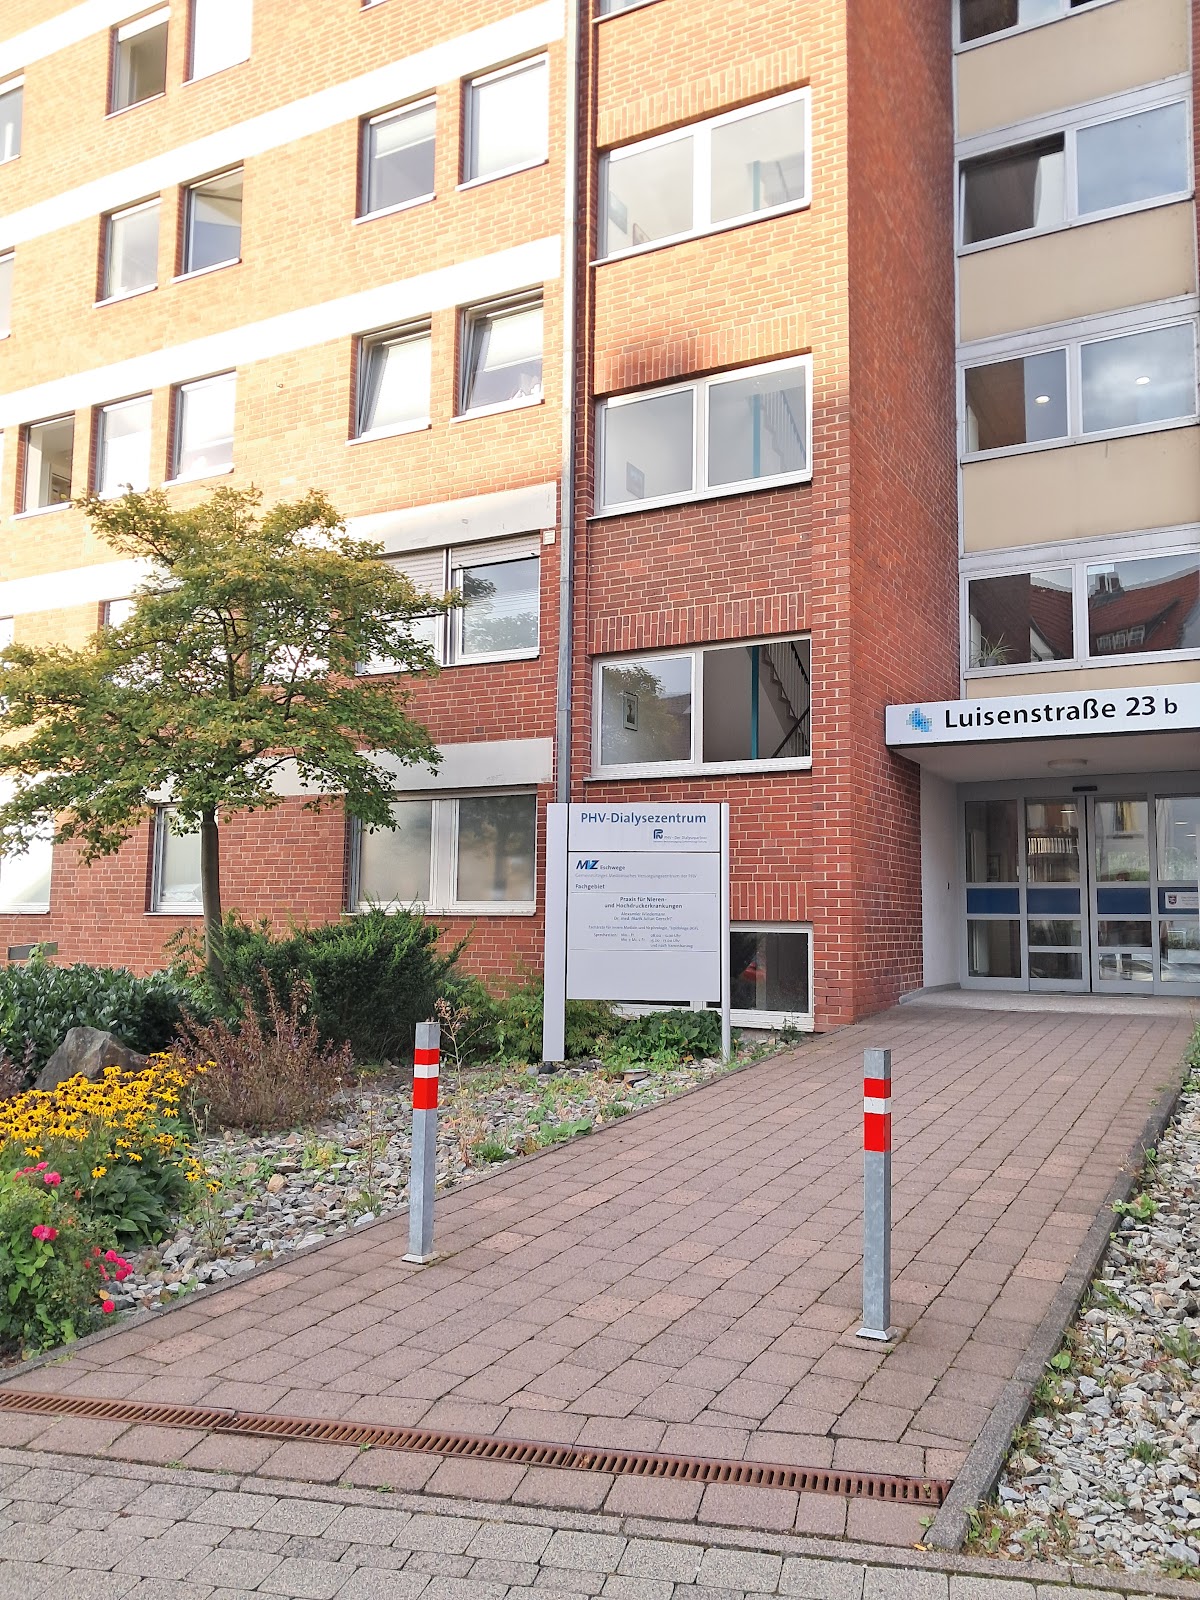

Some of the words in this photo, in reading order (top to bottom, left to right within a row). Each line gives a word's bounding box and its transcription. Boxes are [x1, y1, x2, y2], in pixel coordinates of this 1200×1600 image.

[945, 697, 1116, 729] Luisenstraße
[1125, 695, 1156, 717] 23
[1164, 697, 1179, 715] b
[581, 812, 707, 826] PHV-Dialysezentrum
[575, 859, 600, 870] MVZ
